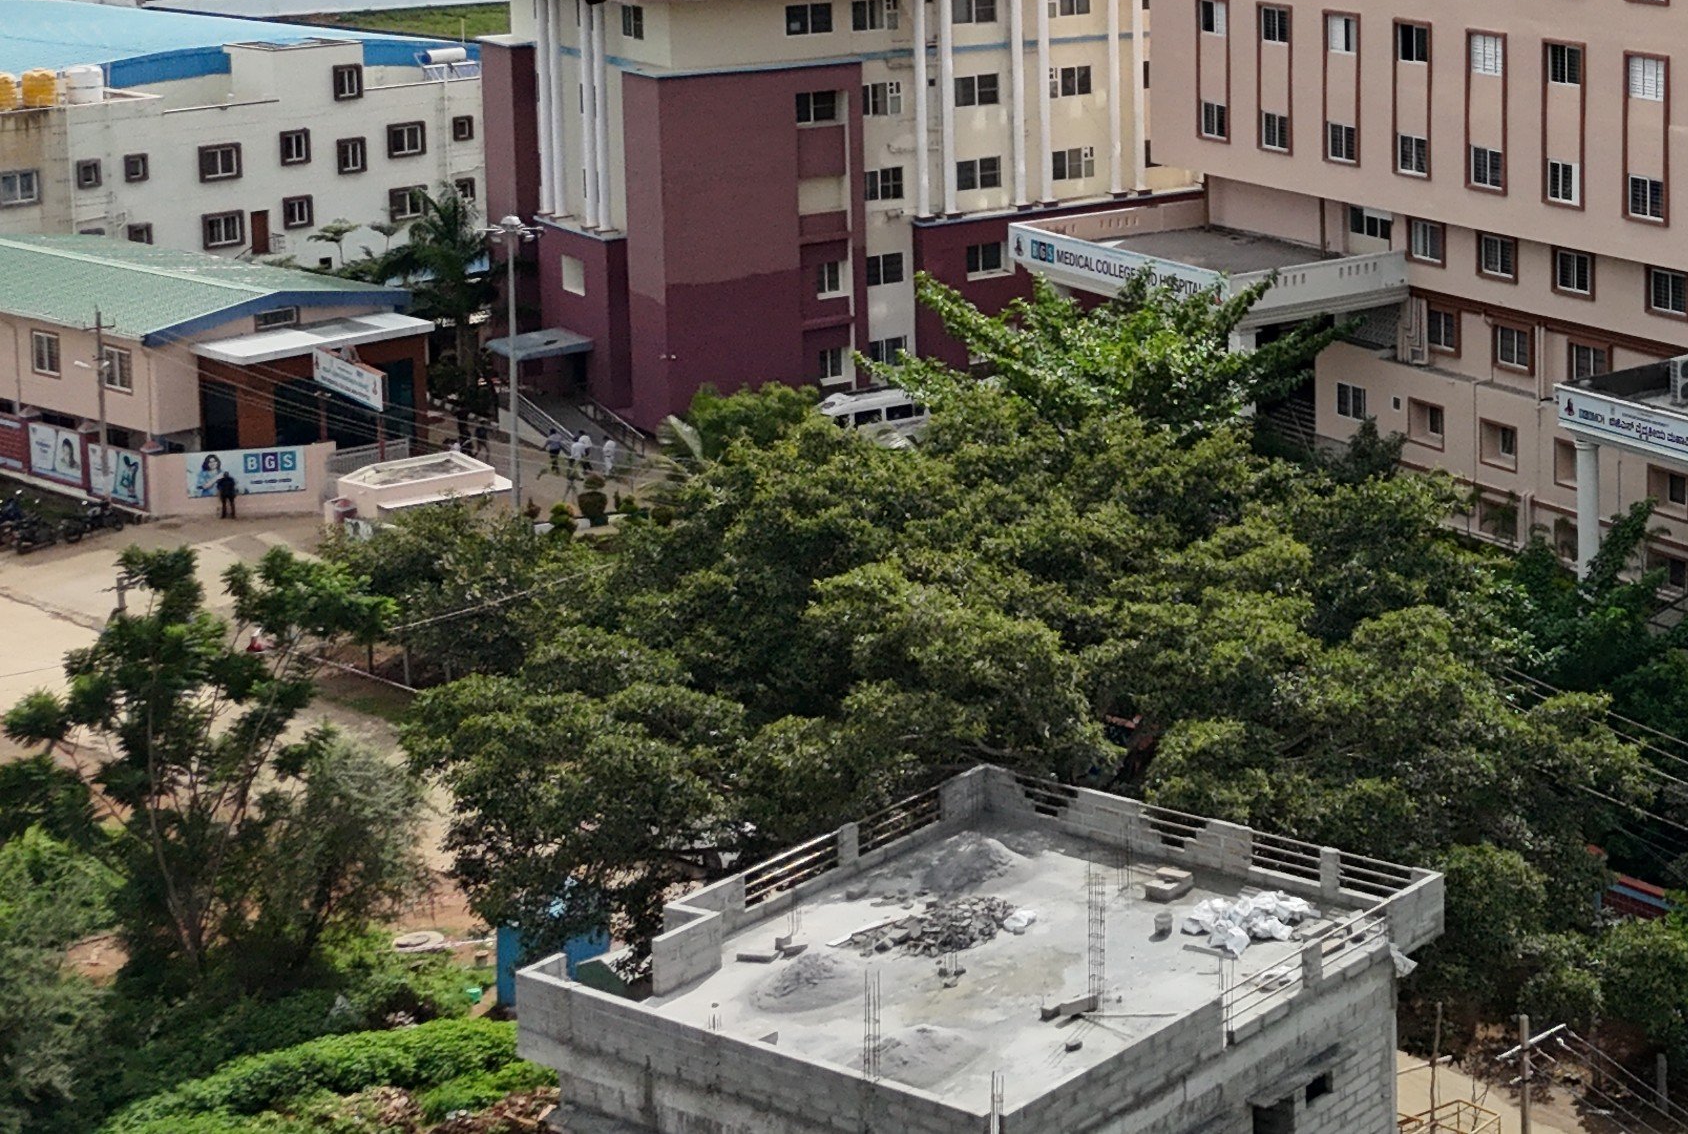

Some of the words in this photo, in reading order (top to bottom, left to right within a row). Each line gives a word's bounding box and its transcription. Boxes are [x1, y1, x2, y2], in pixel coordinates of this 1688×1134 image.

[1032, 241, 1054, 262] BGS
[1056, 249, 1095, 272] MEDICAL
[1096, 259, 1136, 279] COLLEGE
[246, 453, 294, 470] BGS
